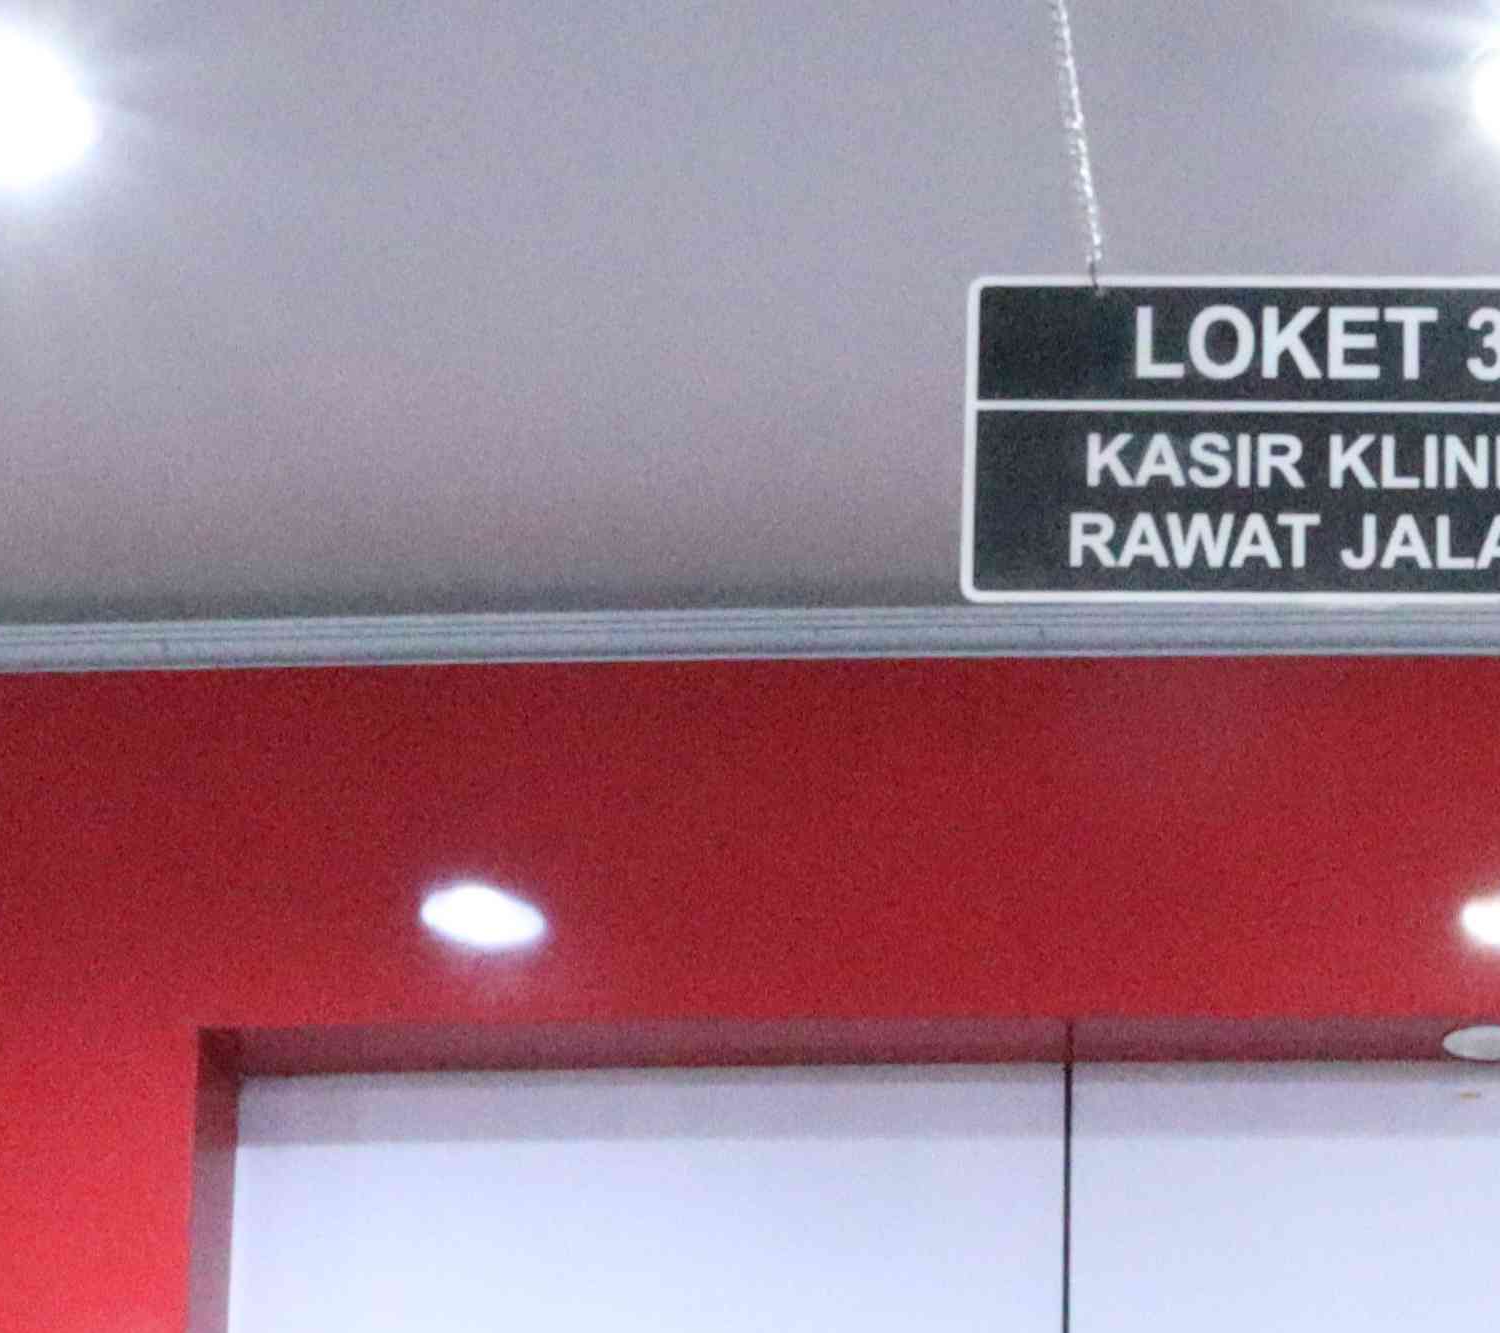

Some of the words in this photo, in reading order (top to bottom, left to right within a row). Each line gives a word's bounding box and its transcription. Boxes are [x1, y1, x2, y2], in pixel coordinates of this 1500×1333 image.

[1134, 305, 1437, 381] LOKET
[1085, 433, 1303, 489] KASIR
[1068, 512, 1320, 569] RAWAT
